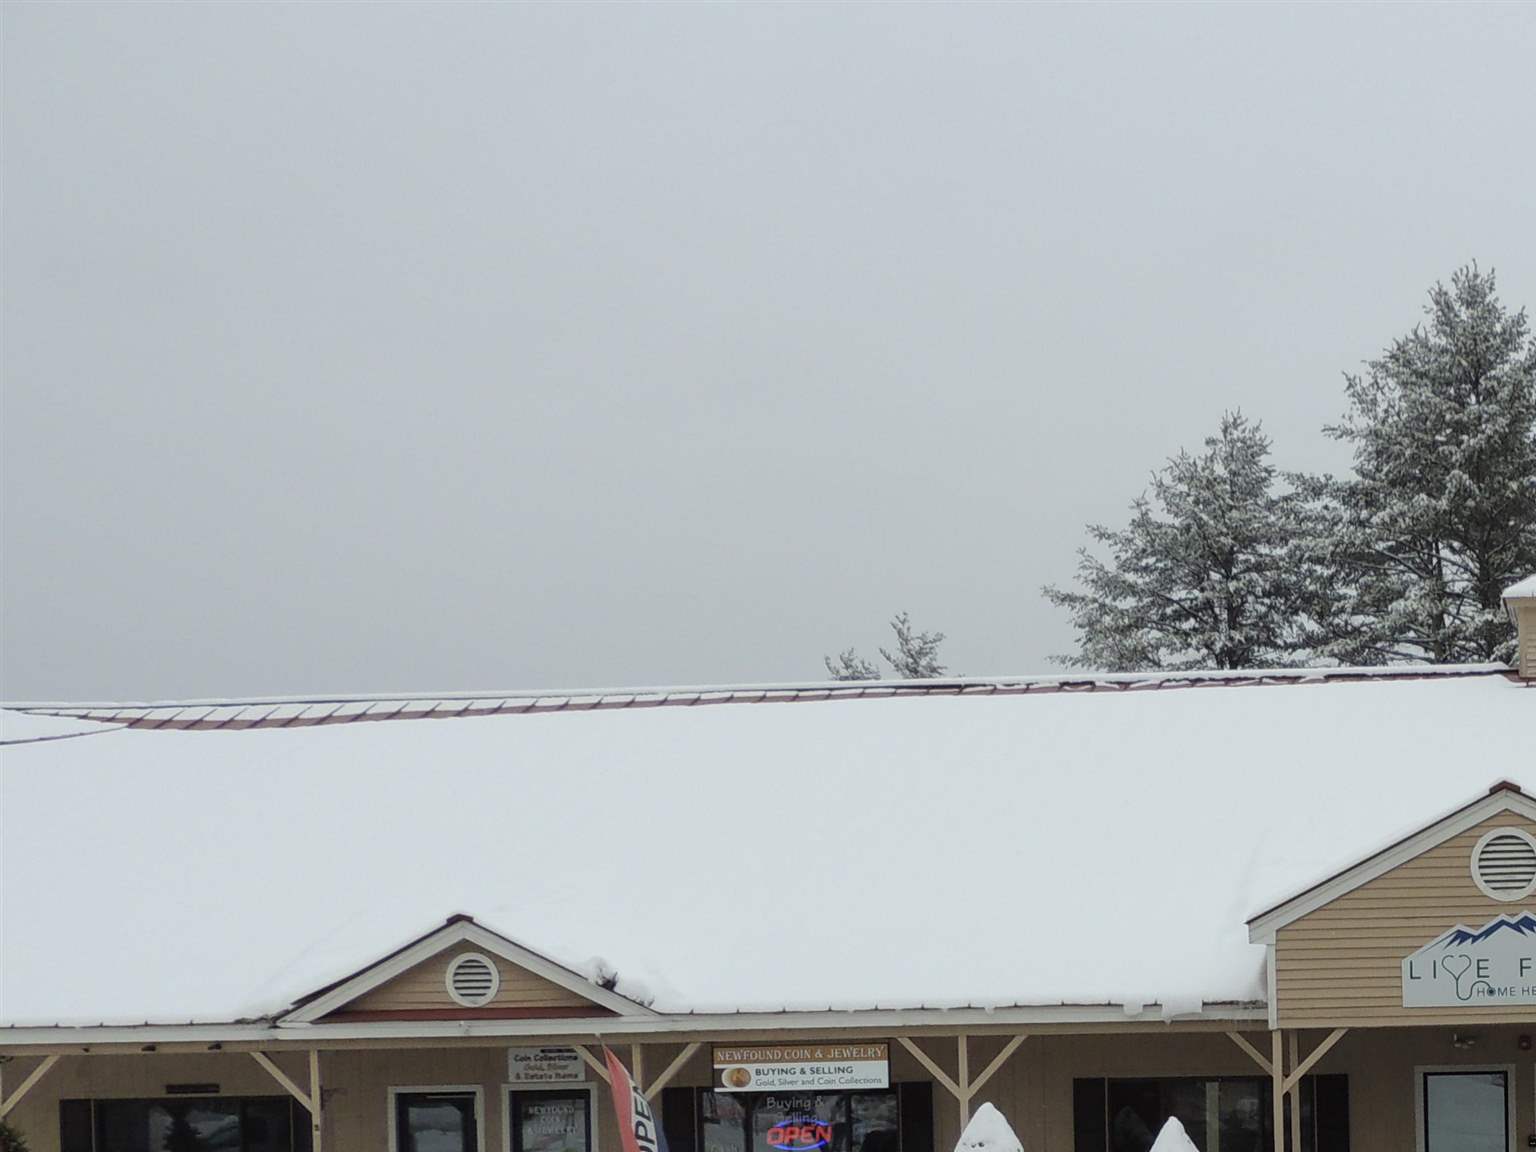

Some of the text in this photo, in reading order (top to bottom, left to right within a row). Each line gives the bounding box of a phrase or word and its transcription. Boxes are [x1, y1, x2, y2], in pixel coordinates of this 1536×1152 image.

[1476, 986, 1516, 997] HOME
[717, 1046, 885, 1061] NEWFOUND COIN & JEWELRY
[755, 1066, 854, 1076] BUYING & SELLING
[778, 1077, 799, 1086] Silver
[801, 1077, 815, 1086] and
[817, 1076, 836, 1085] Coin
[838, 1075, 883, 1085] Collections
[766, 1095, 825, 1111] Buying &
[767, 1126, 833, 1146] OPEN
